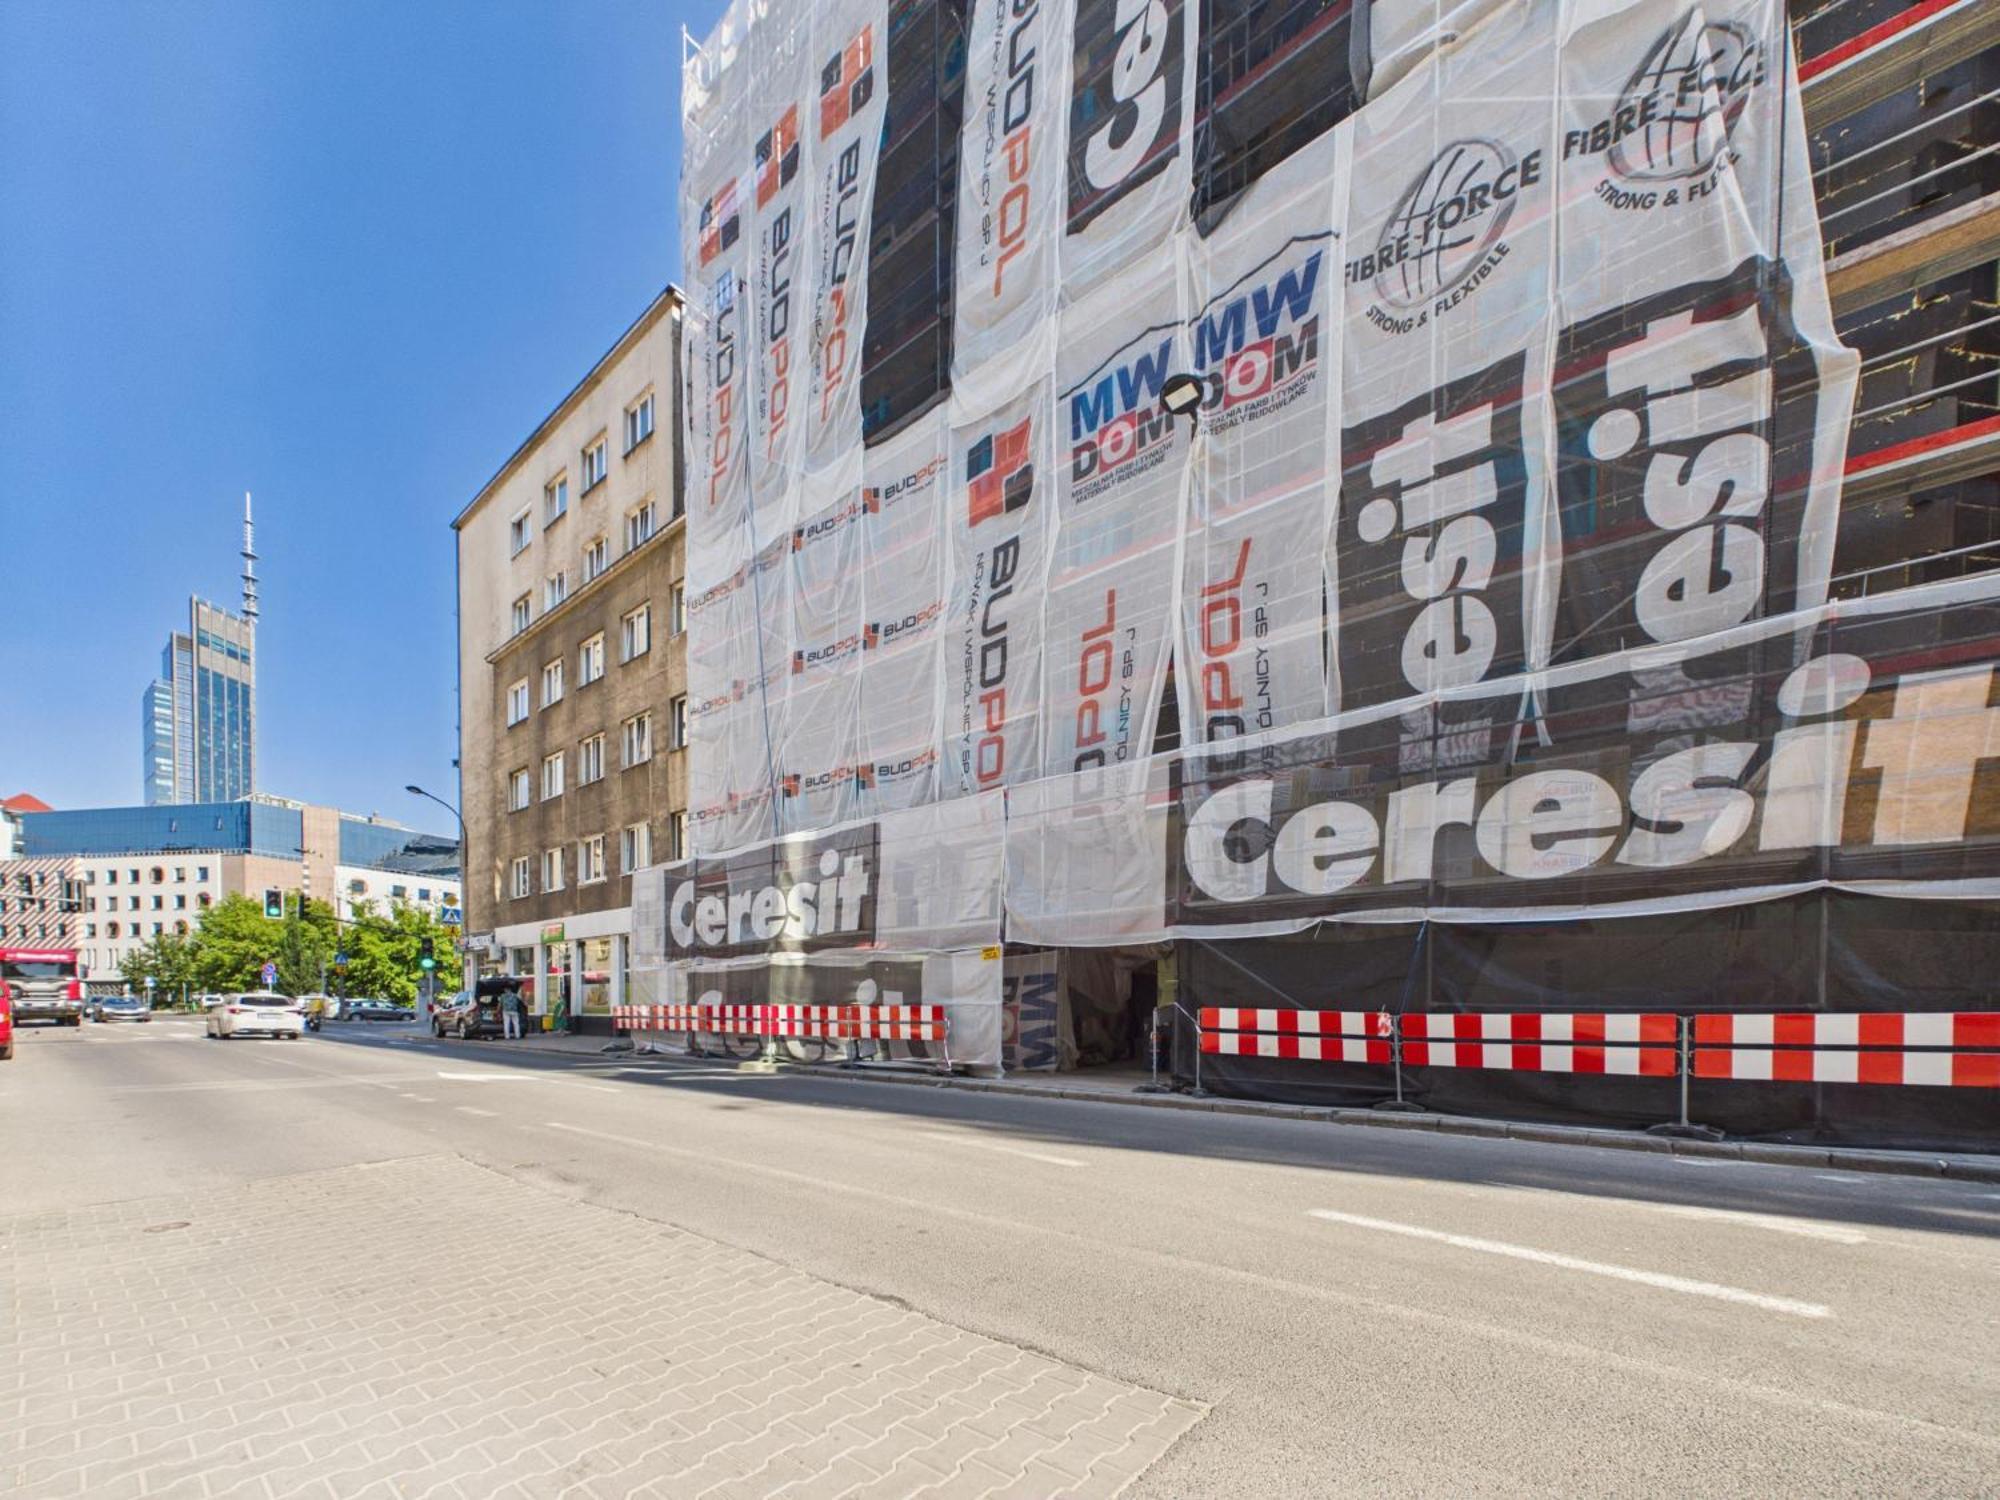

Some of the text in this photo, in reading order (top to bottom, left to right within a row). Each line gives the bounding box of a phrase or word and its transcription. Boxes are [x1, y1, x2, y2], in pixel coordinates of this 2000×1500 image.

[1594, 178, 1658, 210] STRONG
[1663, 187, 1680, 207] &
[767, 206, 791, 462] BUDPOL
[1194, 249, 1324, 371] MW
[1366, 304, 1414, 334] STRONG
[1434, 241, 1511, 317] FLEXIBLE
[1071, 336, 1174, 441] MW
[1199, 313, 1319, 411] DOM
[884, 452, 948, 501] BUDPOL
[1072, 406, 1176, 483] DOM
[807, 634, 861, 662] BUDPOL
[883, 600, 945, 638] BUDPOL
[976, 534, 1021, 793] BUDPO
[878, 747, 939, 777] BUDPOL
[1184, 652, 2000, 904] Ceresit
[670, 848, 869, 949] Ceresit
